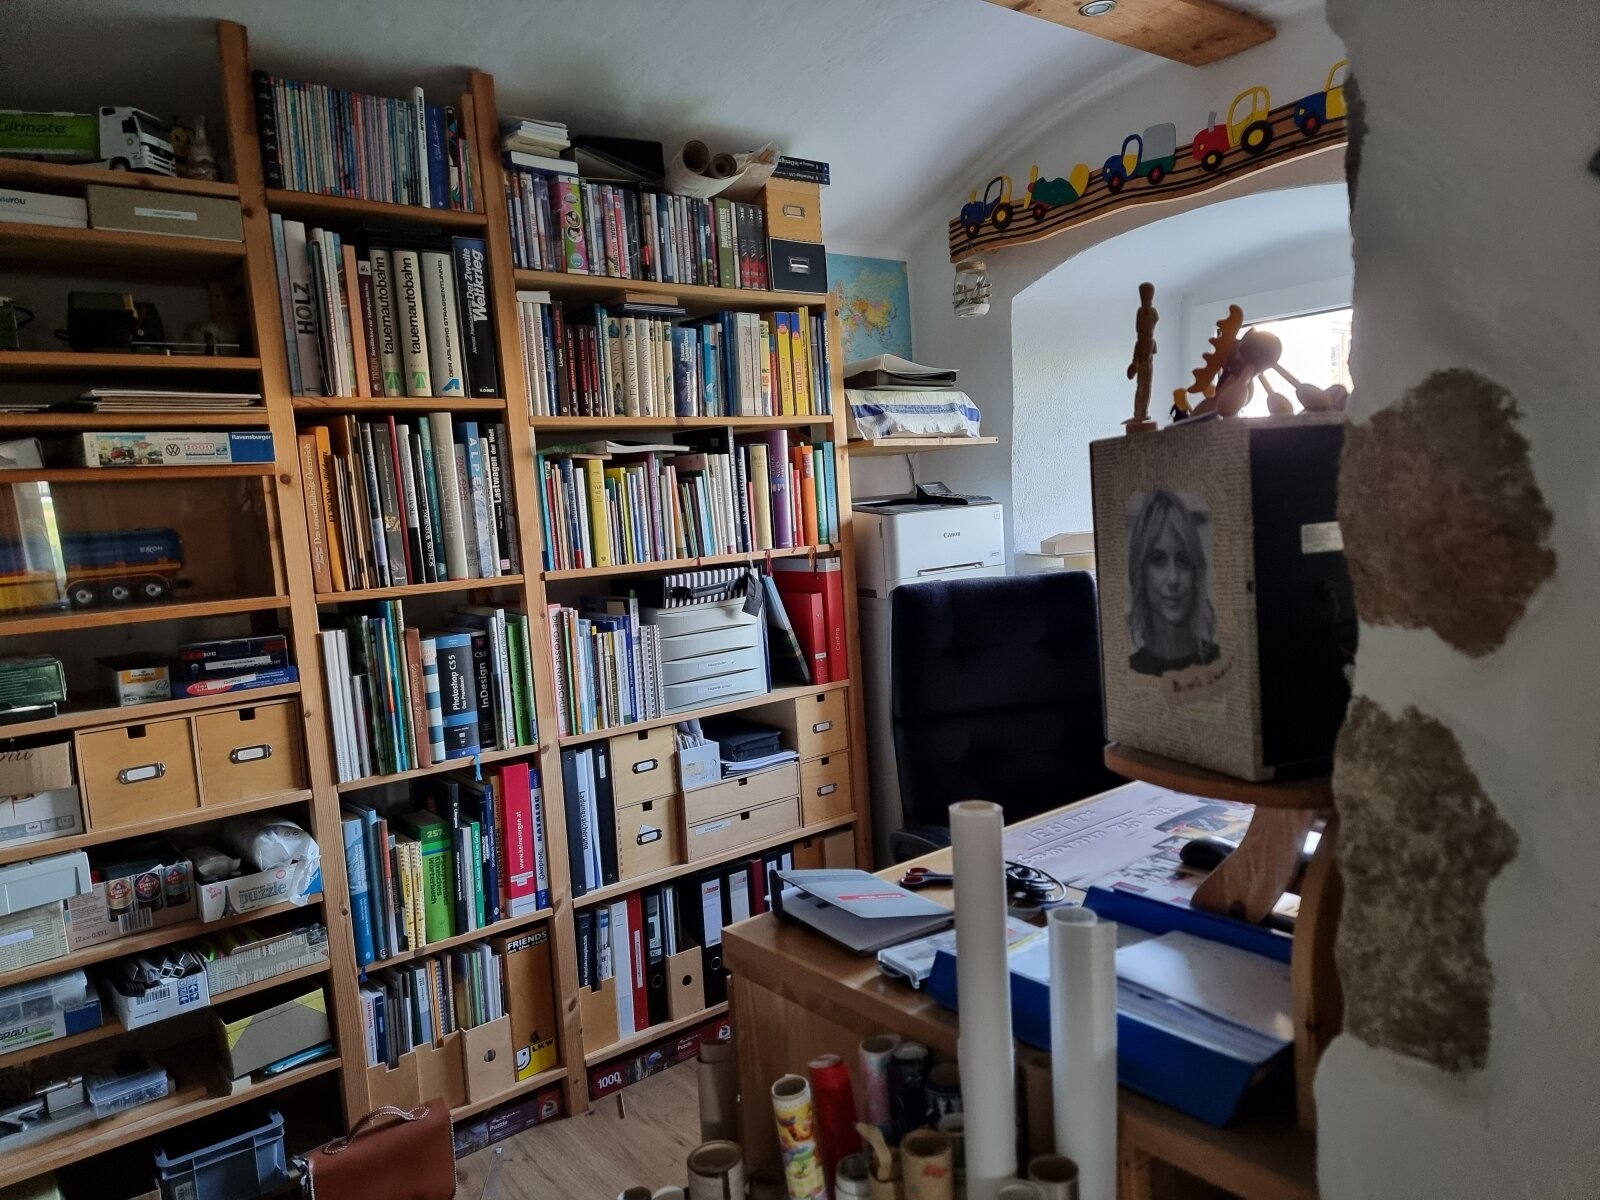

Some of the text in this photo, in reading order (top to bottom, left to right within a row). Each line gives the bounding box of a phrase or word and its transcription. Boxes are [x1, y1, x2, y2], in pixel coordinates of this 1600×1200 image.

[375, 256, 394, 354] tauernautobahn
[402, 257, 421, 354] tauernautobahn
[438, 258, 450, 326] STRASSENTUNNEL
[466, 282, 474, 298] Der
[472, 250, 487, 322] Weltkrieg
[293, 282, 315, 335] HOLZ
[444, 327, 452, 360] ARLBERG
[612, 340, 621, 377] SPANIEN
[628, 339, 637, 397] FRANKREICH
[231, 434, 272, 442] Ravensburger
[303, 444, 314, 480] Österreich
[493, 456, 502, 503] Lastwagen
[408, 492, 416, 516] TRAUN
[426, 541, 434, 567] SCHLOSS
[553, 631, 562, 664] GROSSE
[448, 654, 462, 711] Photoshop CS5
[480, 662, 490, 708] InDesign
[556, 667, 566, 716] NÄHSCHULE
[534, 796, 542, 842] KATALOG
[578, 790, 588, 850] Ladungssicherung
[239, 882, 287, 902] puzzle
[428, 856, 437, 904] Wörterbuch
[507, 930, 548, 951] FRIENDS
[532, 1039, 554, 1052] LKW
[598, 1071, 622, 1089] 1000
[489, 1120, 508, 1132] Puzzle
